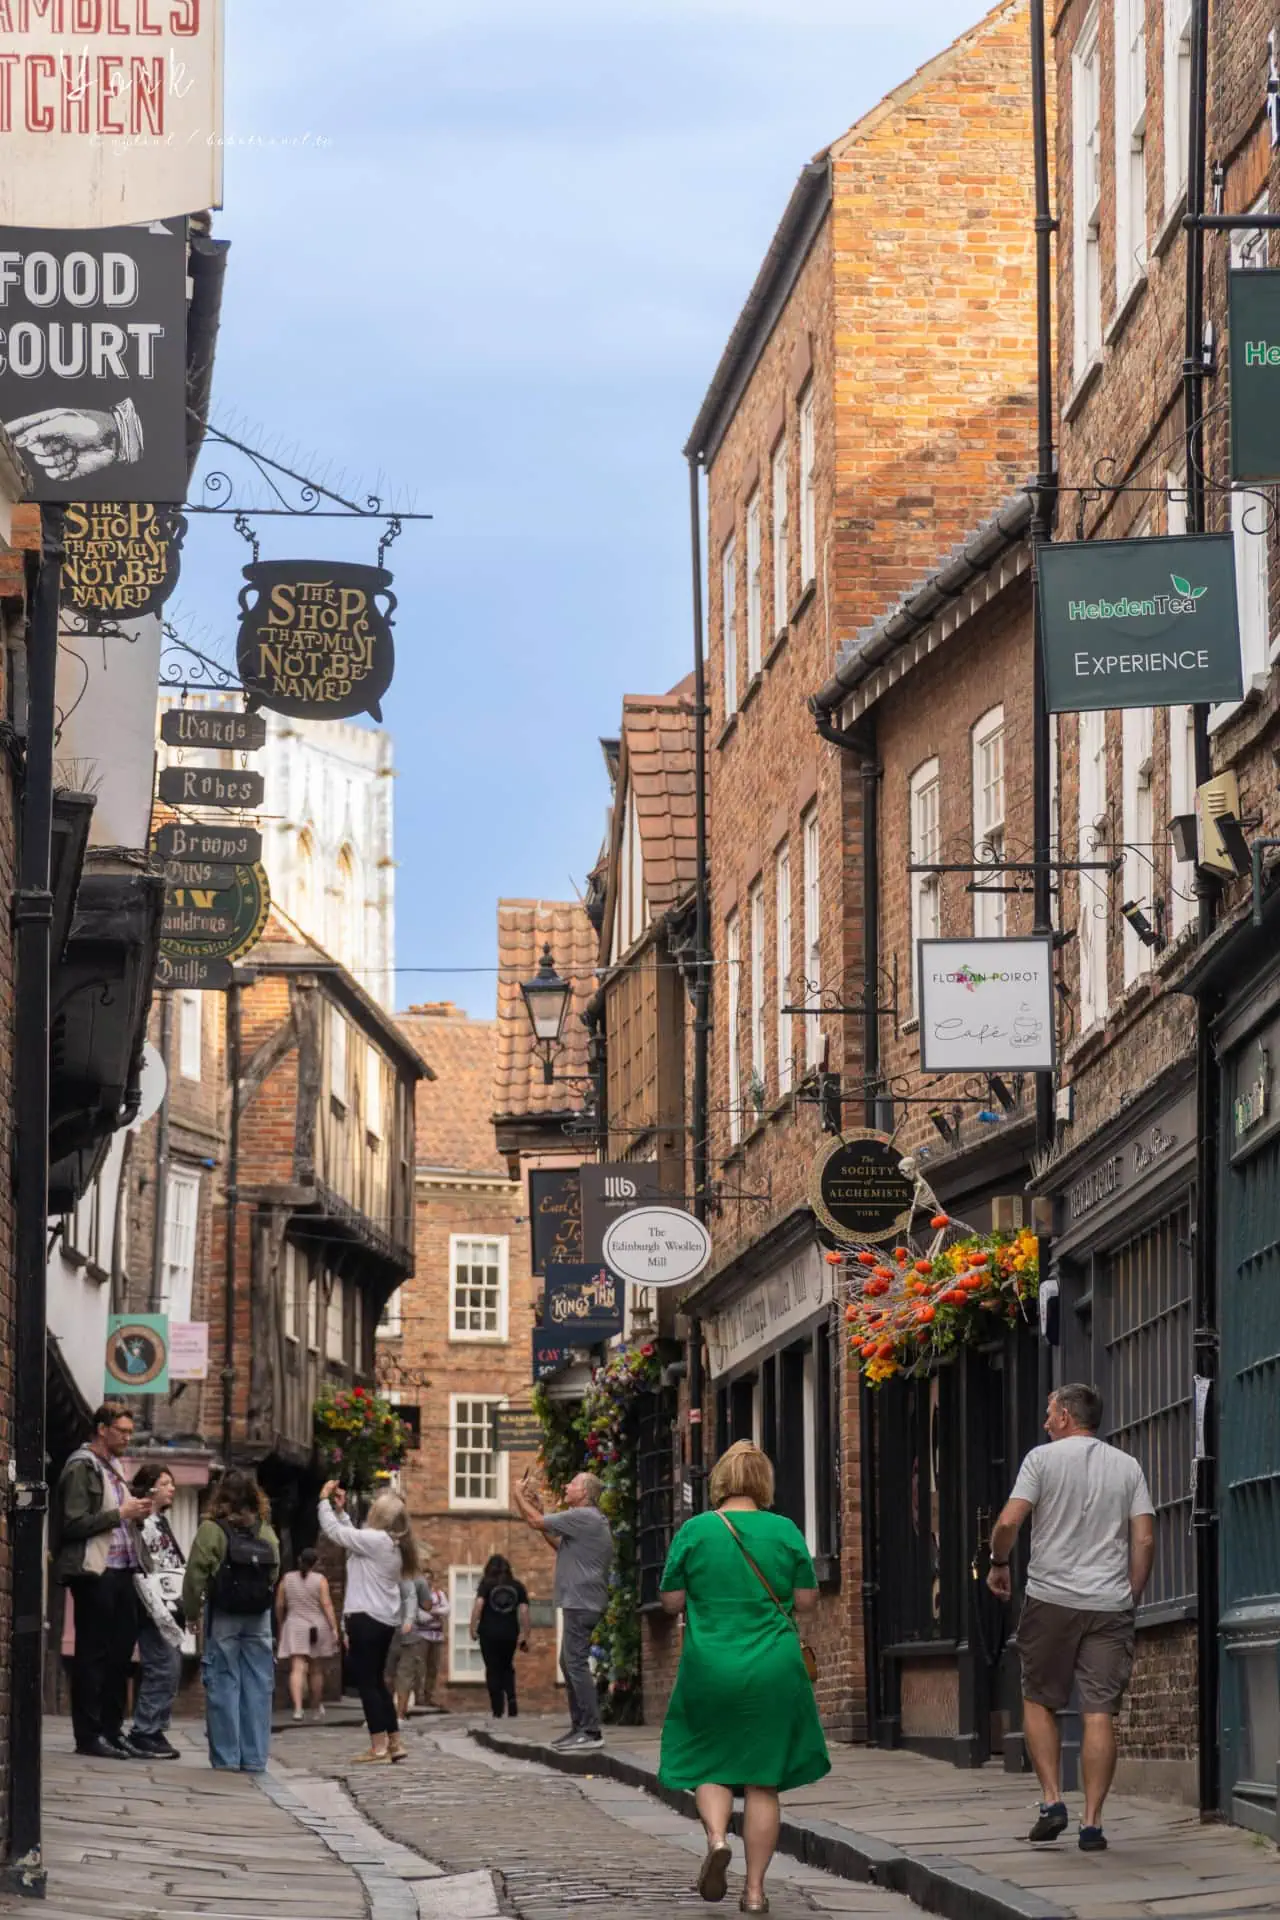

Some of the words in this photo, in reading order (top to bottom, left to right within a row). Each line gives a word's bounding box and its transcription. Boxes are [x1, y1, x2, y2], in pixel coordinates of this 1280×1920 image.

[0, 251, 140, 308] FOOD
[0, 322, 165, 381] OURT
[63, 503, 155, 539] SHOP
[63, 541, 116, 560] THAT
[60, 556, 117, 589] NOT
[119, 560, 165, 587] BE
[72, 585, 151, 610] NAMED
[296, 580, 340, 607] THE
[268, 584, 367, 631] SHOP
[1068, 594, 1197, 621] HebdenTea
[257, 627, 323, 650] THAT
[322, 610, 377, 670] MUST
[257, 643, 324, 679] NOT
[322, 653, 368, 681] BE
[273, 675, 352, 702] NAMED
[177, 712, 247, 743] Wands
[183, 771, 253, 800] Robes
[170, 828, 248, 858] Brooms
[163, 911, 226, 933] auldrons
[155, 958, 208, 986] Quills
[992, 971, 1039, 983] POIROT
[934, 1017, 1009, 1045] Café
[840, 1166, 895, 1175] SOCIETY
[861, 1155, 875, 1164] The
[829, 1188, 908, 1198] ALCHEMISTS
[863, 1178, 873, 1186] of
[648, 1226, 667, 1238] The
[612, 1241, 660, 1255] Edinburgh
[665, 1241, 702, 1252] Woollen
[648, 1257, 667, 1268] Mill
